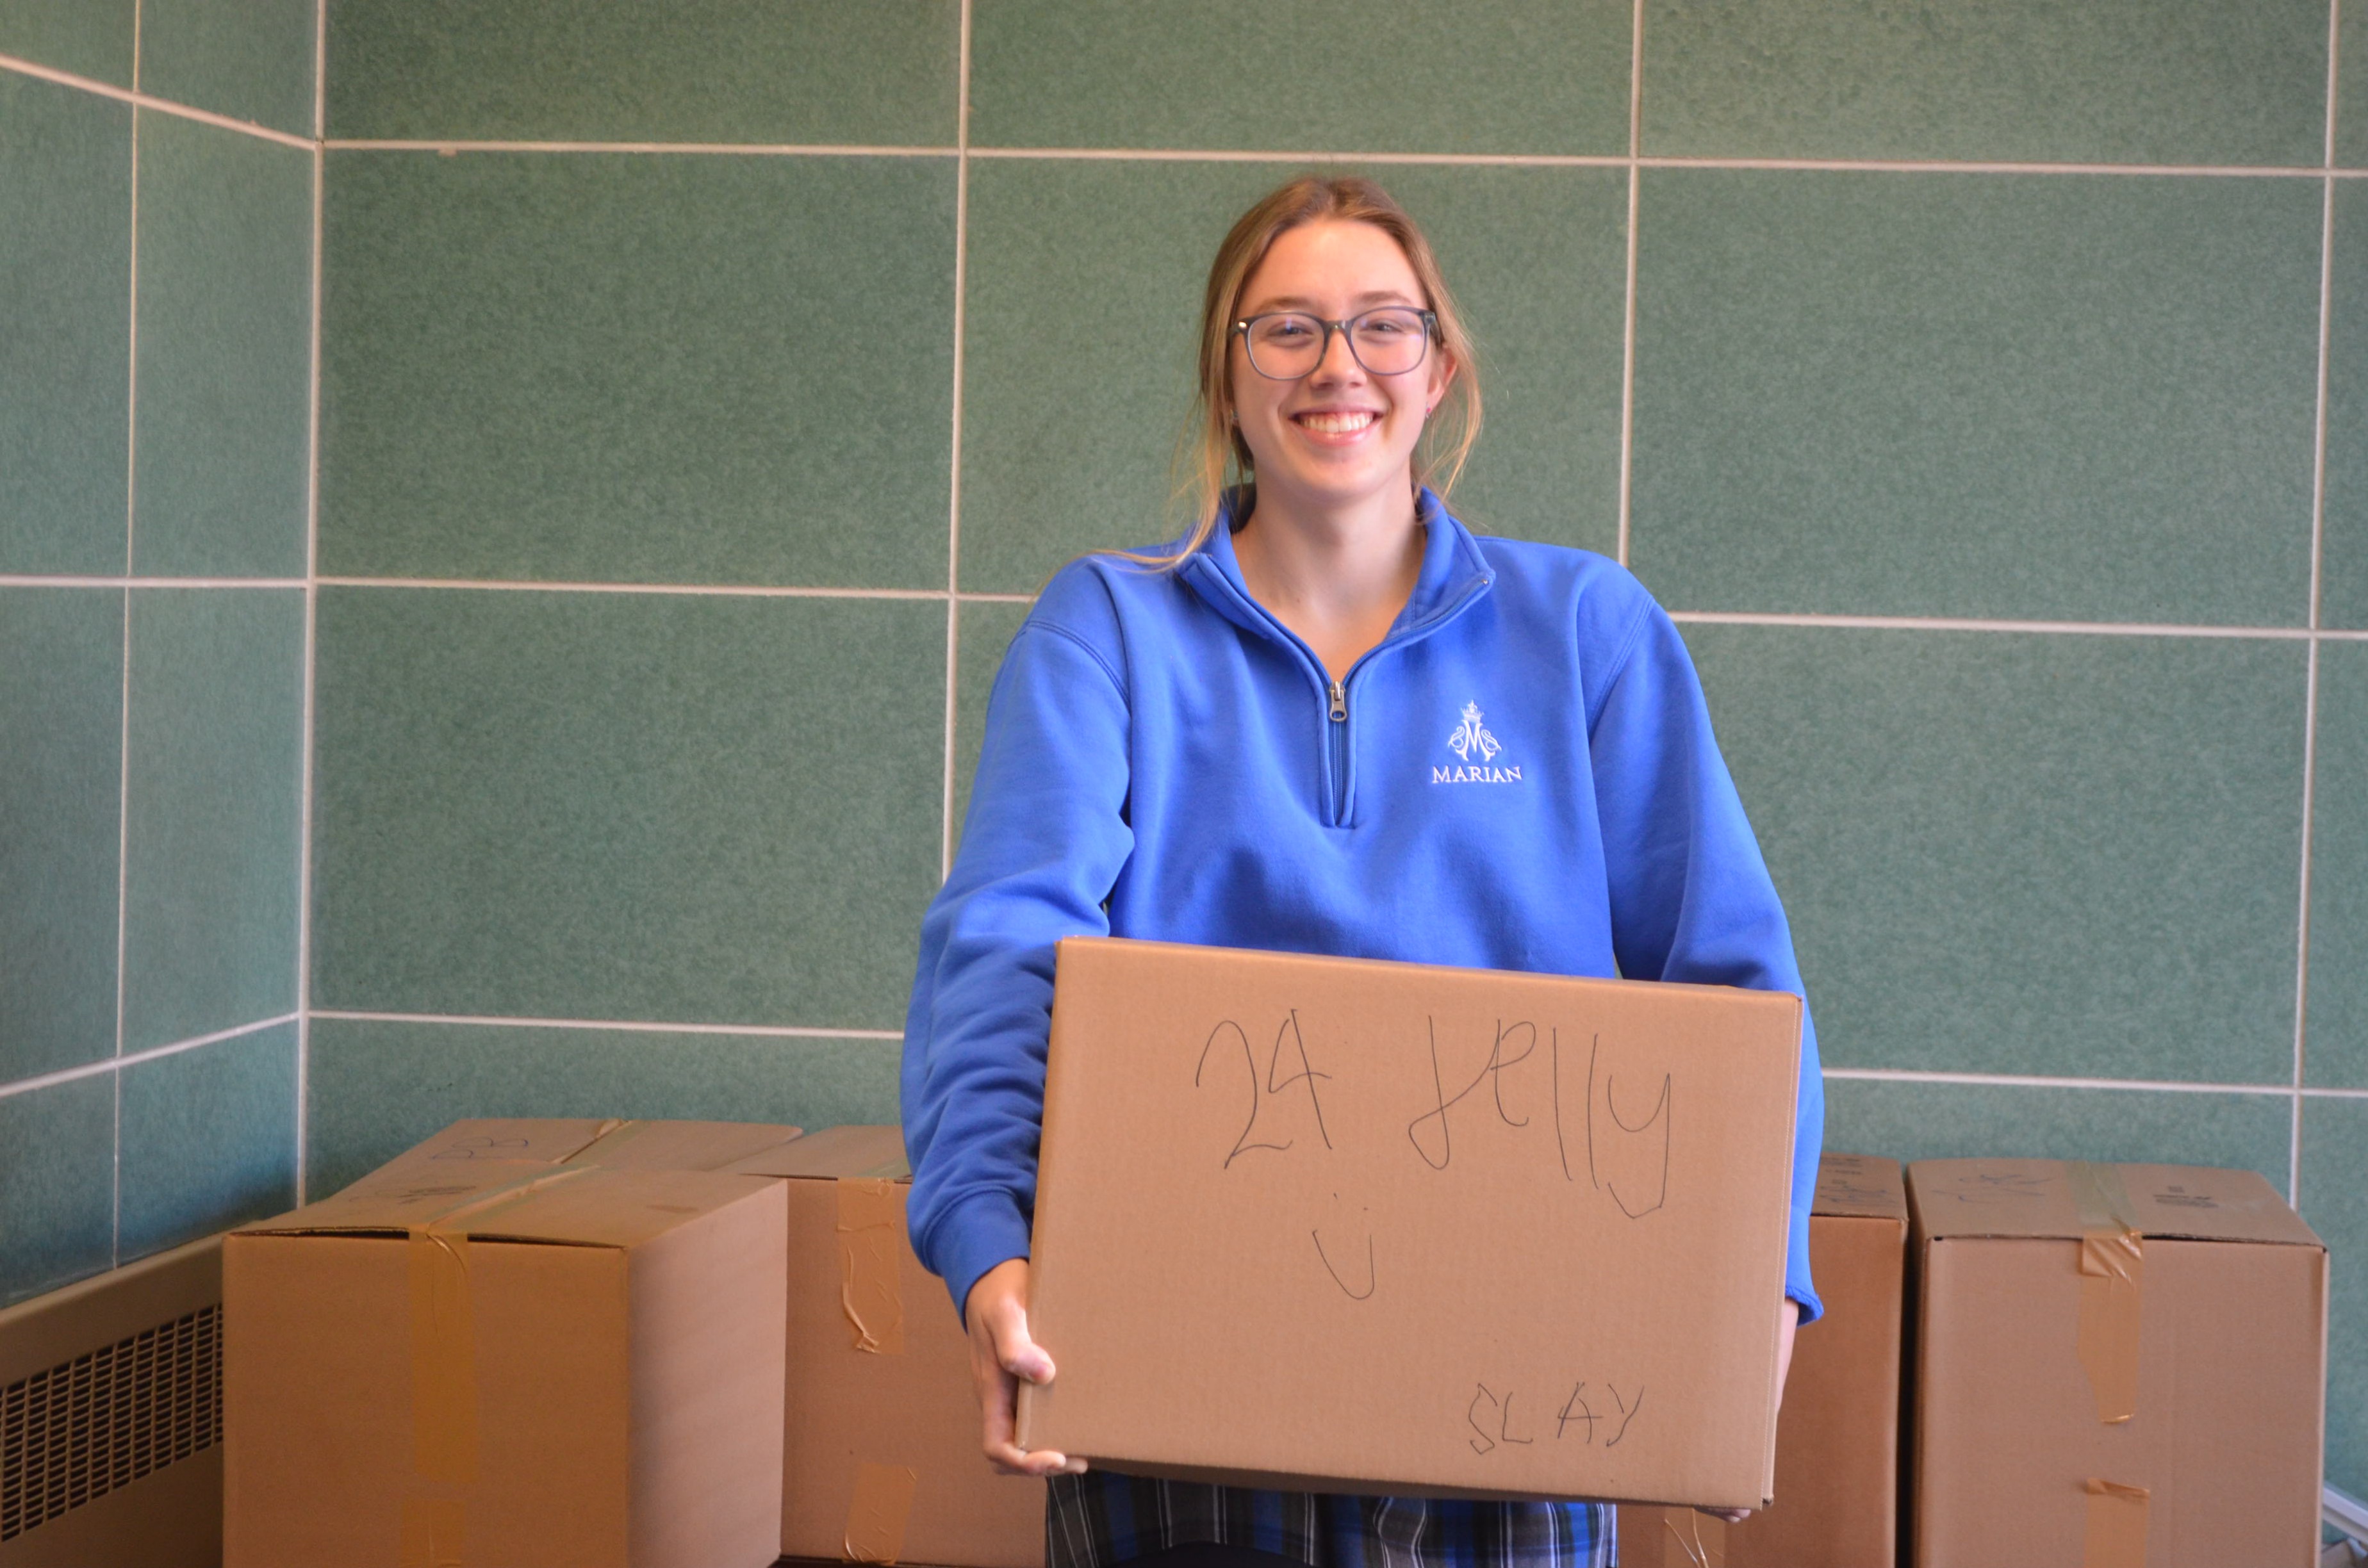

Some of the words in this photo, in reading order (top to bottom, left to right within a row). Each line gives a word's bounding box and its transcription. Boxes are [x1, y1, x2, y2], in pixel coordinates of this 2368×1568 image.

[1432, 765, 1523, 784] MARIAN
[1196, 1008, 1333, 1170] 24
[1408, 1015, 1671, 1220] Jelly
[1468, 1382, 1645, 1455] SLAY
